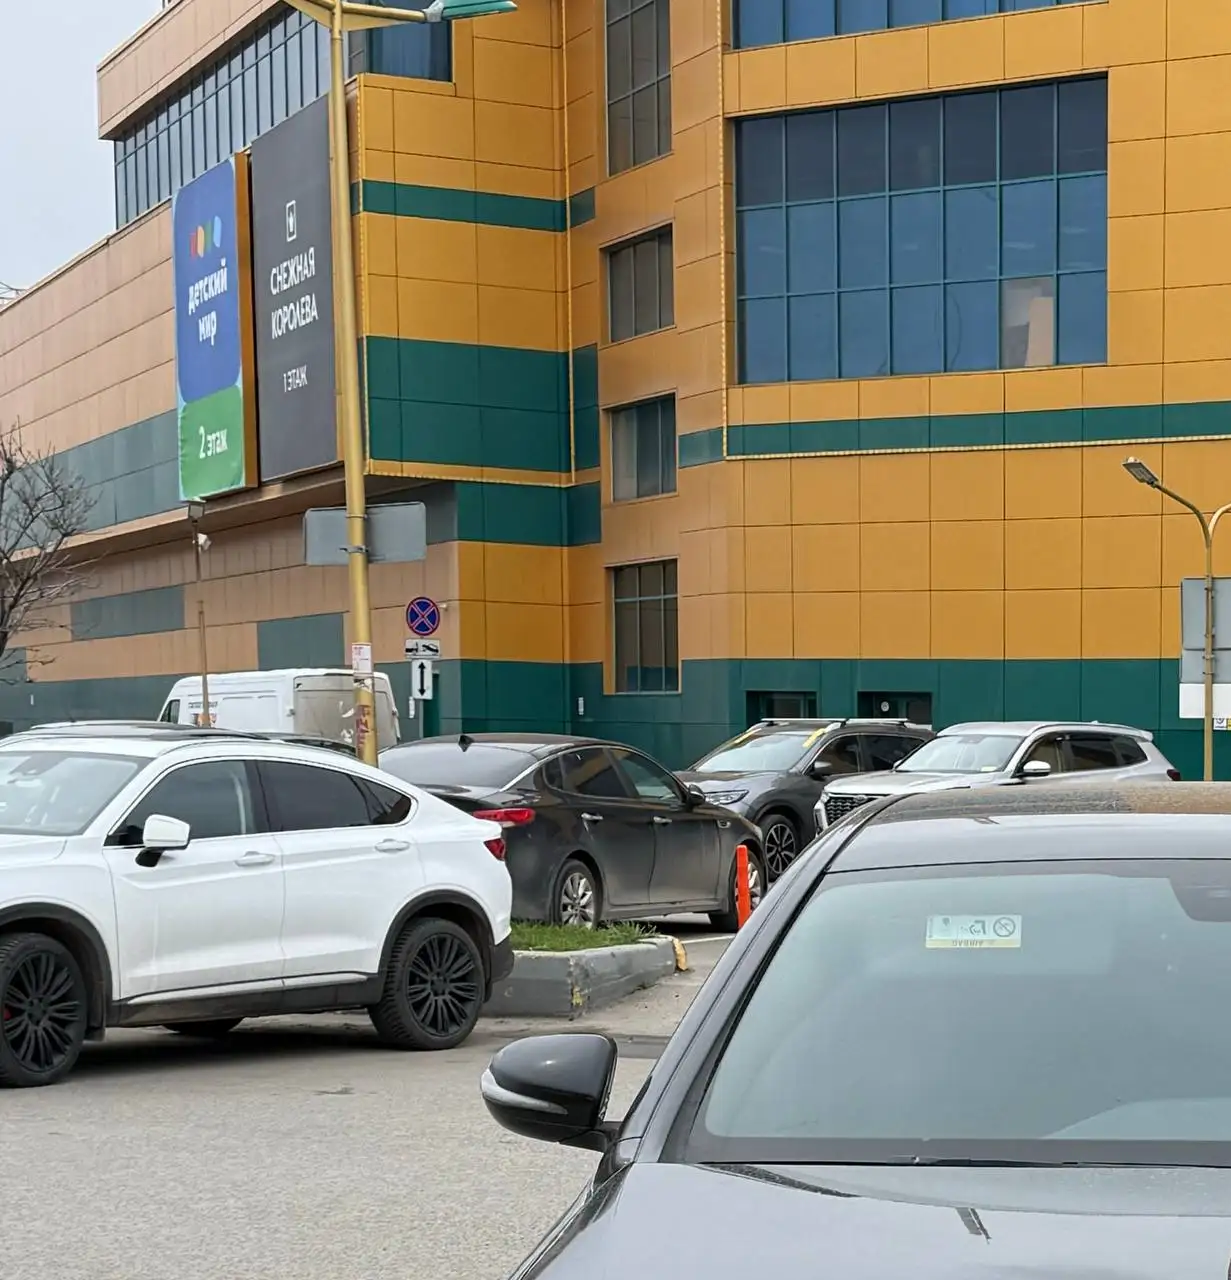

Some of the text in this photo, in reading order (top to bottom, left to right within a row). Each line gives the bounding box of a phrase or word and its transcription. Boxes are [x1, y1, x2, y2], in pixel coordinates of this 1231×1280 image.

[188, 258, 228, 315] детский
[270, 247, 316, 295] СНЕЖНАЯ
[198, 311, 218, 345] мир
[271, 293, 319, 339] КОРОЛЕВА
[287, 364, 308, 391] ЭТАЖ
[199, 425, 228, 459] 2 этаж
